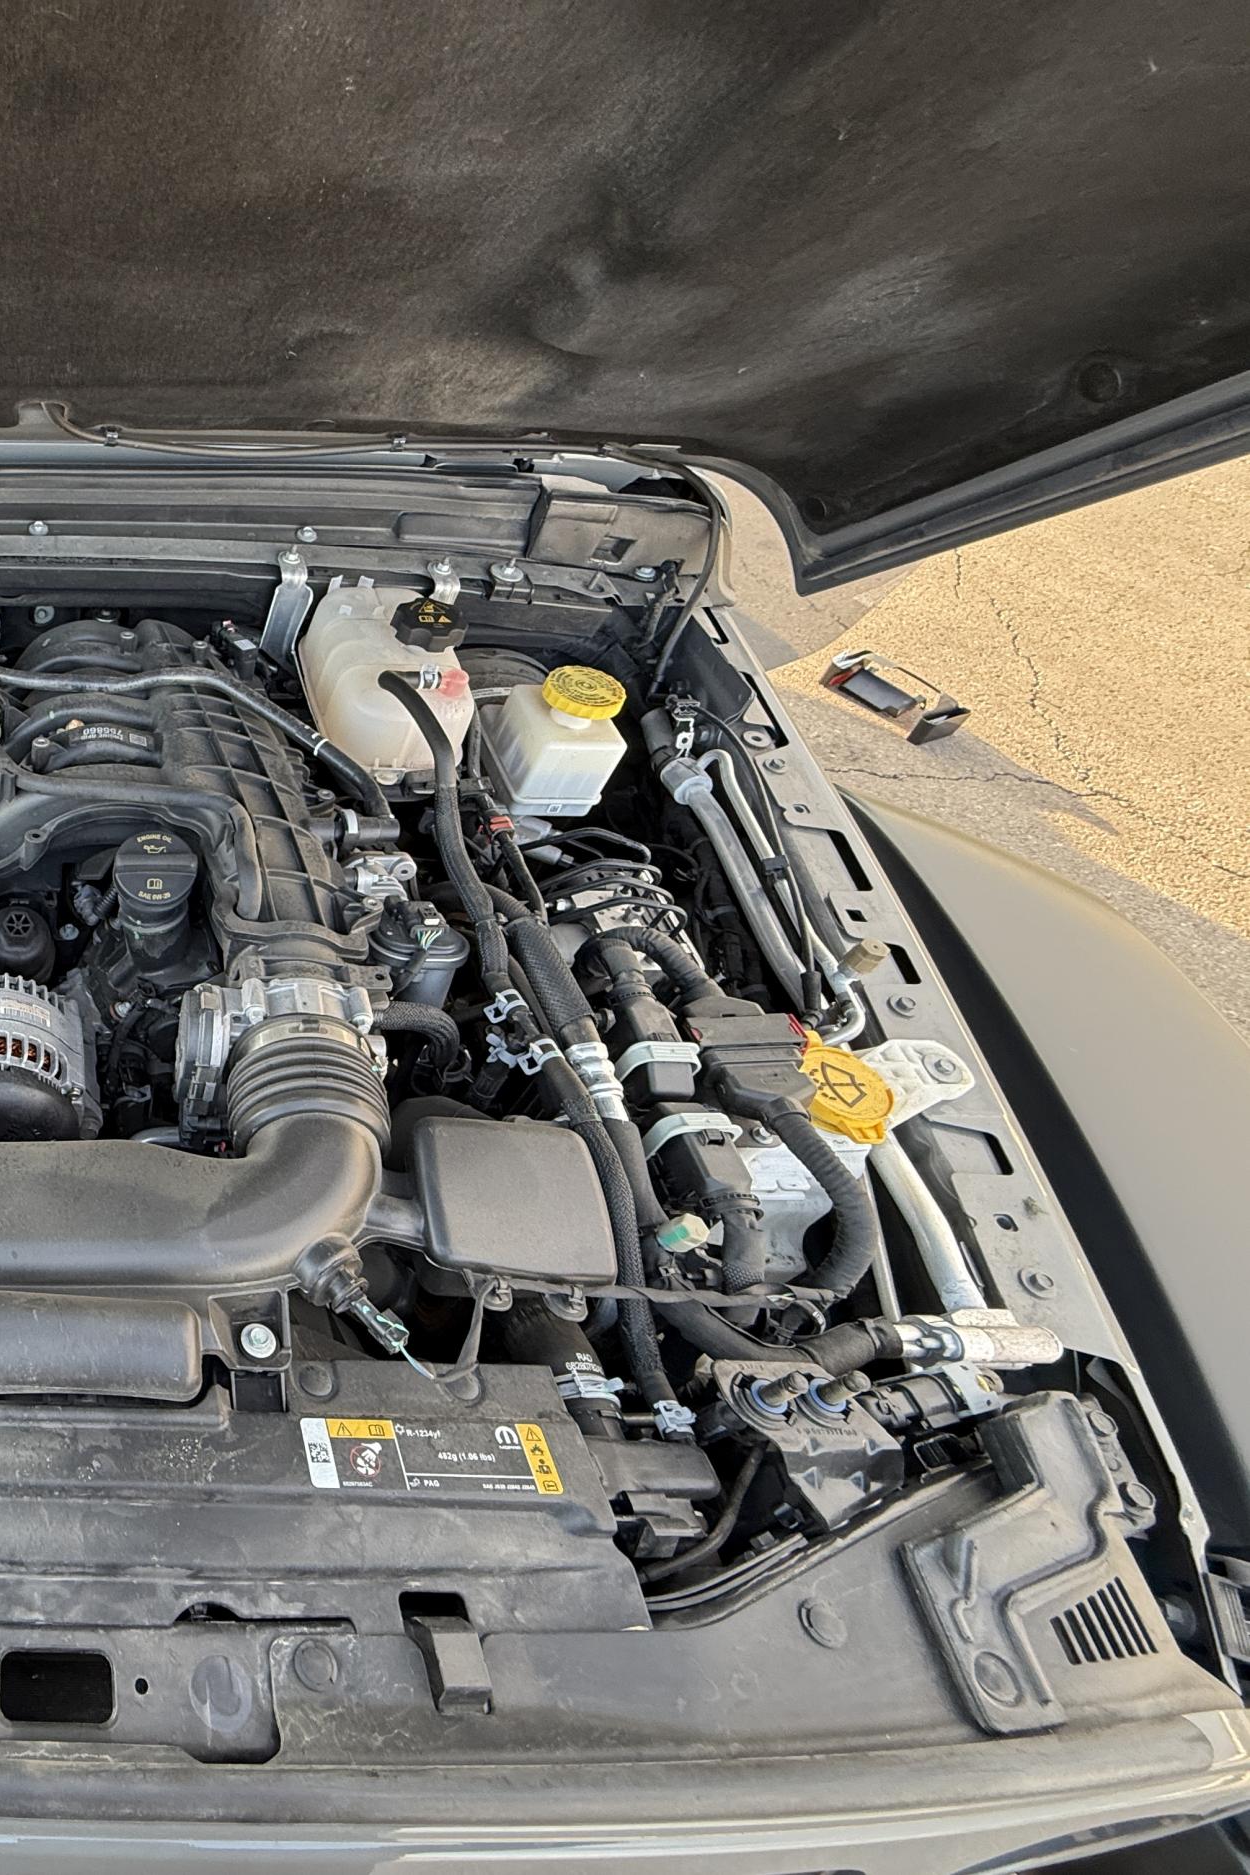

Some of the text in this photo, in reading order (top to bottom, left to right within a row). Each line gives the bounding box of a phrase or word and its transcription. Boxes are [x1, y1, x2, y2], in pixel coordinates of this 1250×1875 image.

[136, 833, 173, 844] ENGINE OIL
[423, 1479, 440, 1487] PAG
